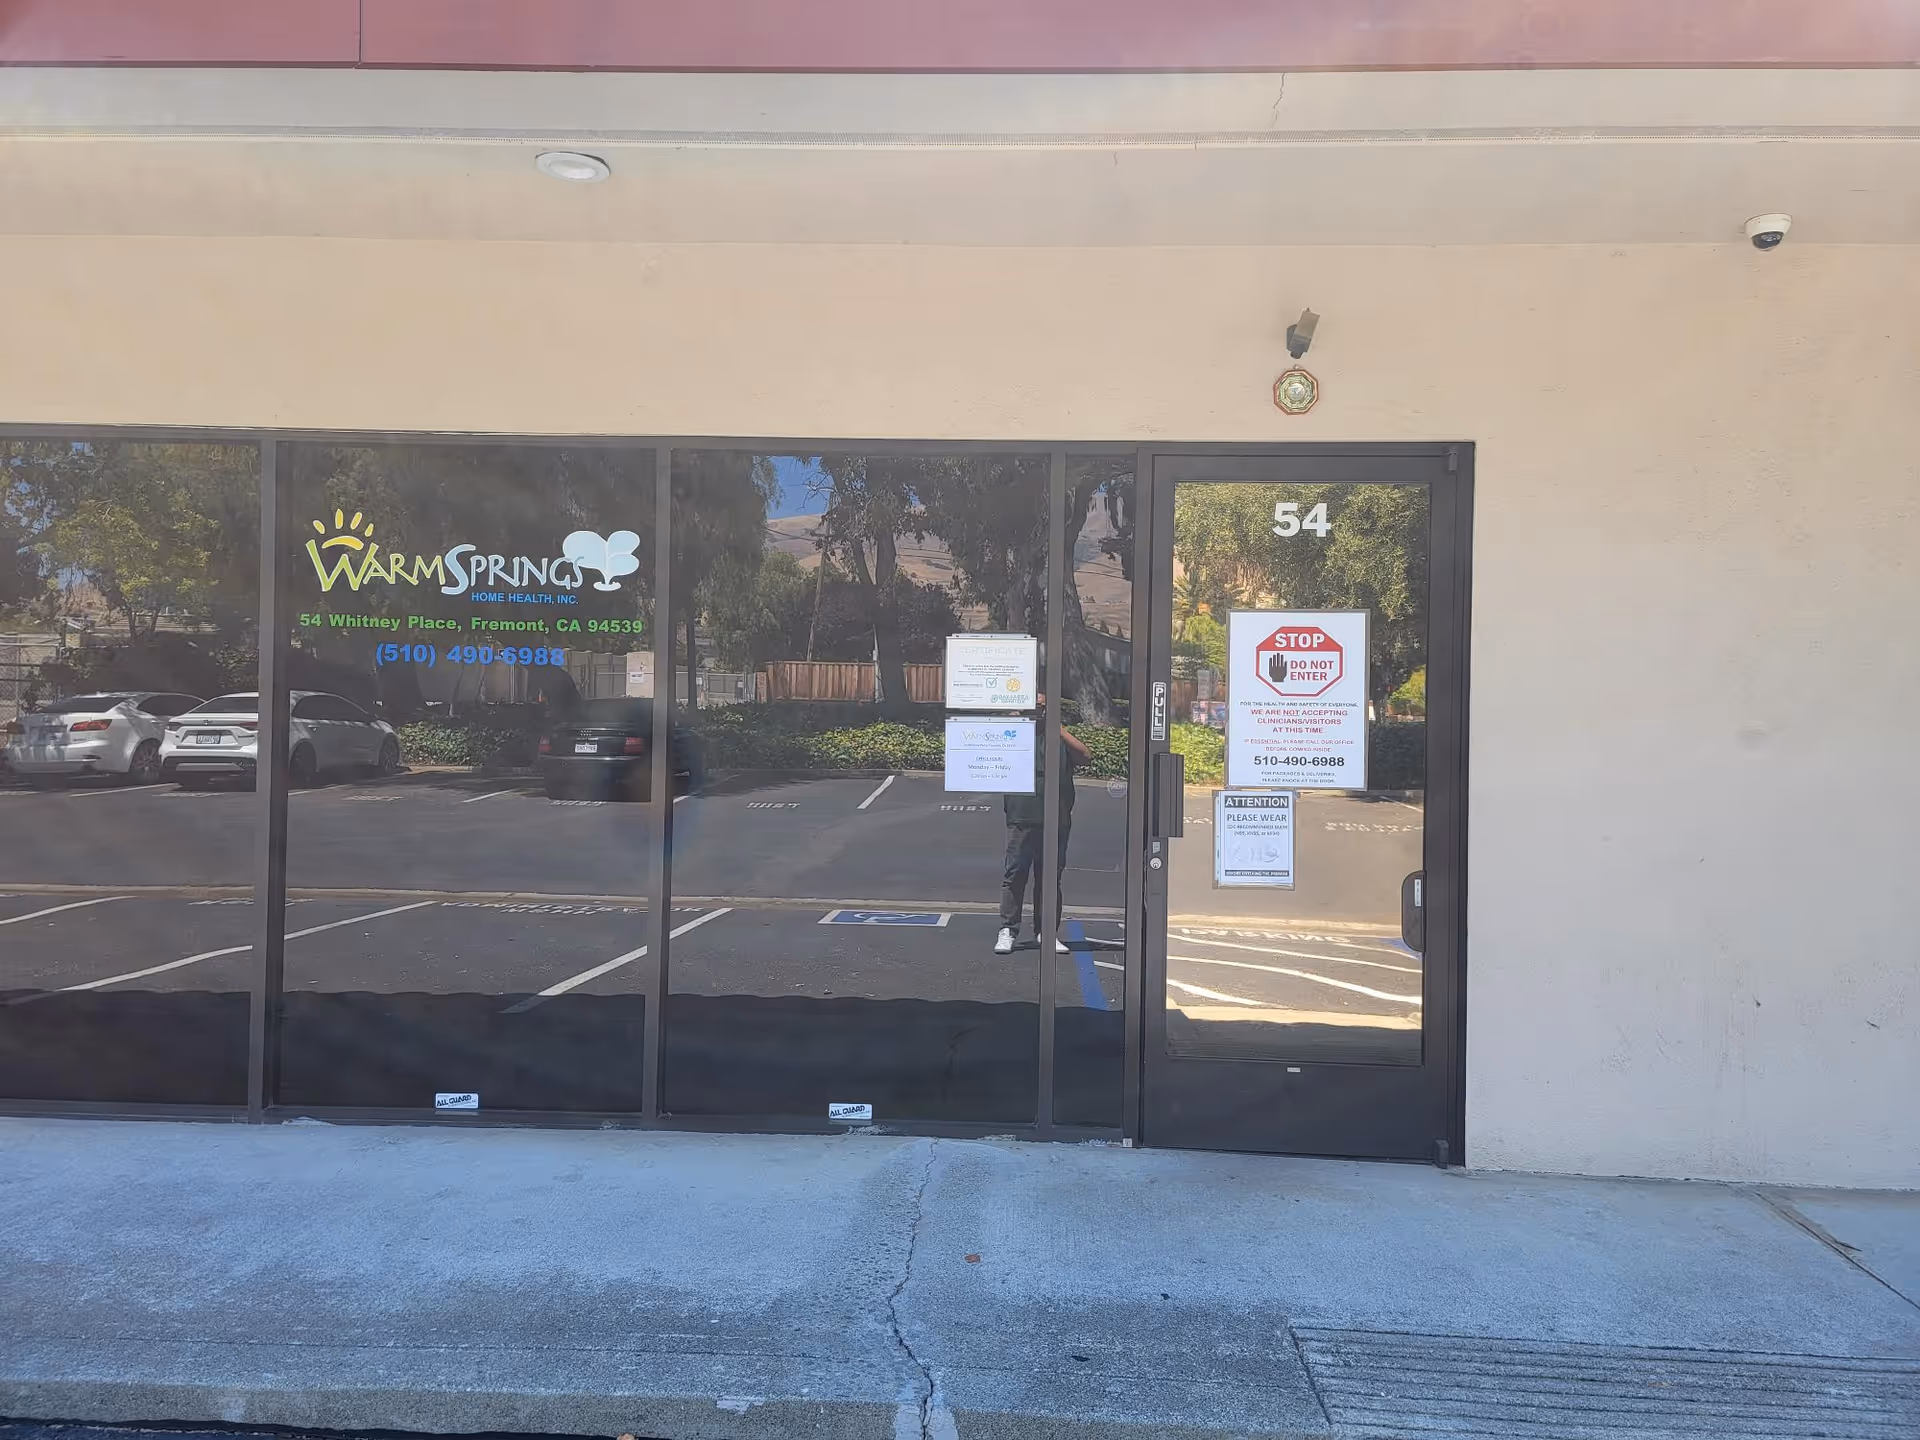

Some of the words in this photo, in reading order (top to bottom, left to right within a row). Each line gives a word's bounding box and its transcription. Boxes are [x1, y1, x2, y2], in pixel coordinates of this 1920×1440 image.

[1272, 502, 1331, 537] 54
[471, 592, 505, 602] HOME
[508, 593, 554, 605] HEALTH,
[557, 595, 579, 604] INC.
[300, 614, 322, 626] 54
[329, 614, 400, 631] Whitney
[408, 616, 462, 632] Place,
[471, 617, 550, 634] Fremont,
[556, 618, 581, 633] CA
[587, 619, 643, 633] 94539
[1274, 633, 1325, 648] STOP
[376, 643, 436, 667] (510)
[446, 645, 565, 667] 490-6988
[1290, 660, 1307, 670] DO
[1310, 660, 1334, 670] NOT
[1290, 671, 1328, 681] ENTER
[1155, 687, 1164, 726] PULL
[1301, 709, 1348, 717] ACCEPTING
[1254, 755, 1345, 767] 510-490-6988
[1225, 797, 1288, 807] ATTENTION
[436, 1099, 448, 1107] ALL
[448, 1095, 472, 1104] GUARD
[830, 1109, 842, 1117] ALL
[842, 1105, 865, 1114] GUARD
